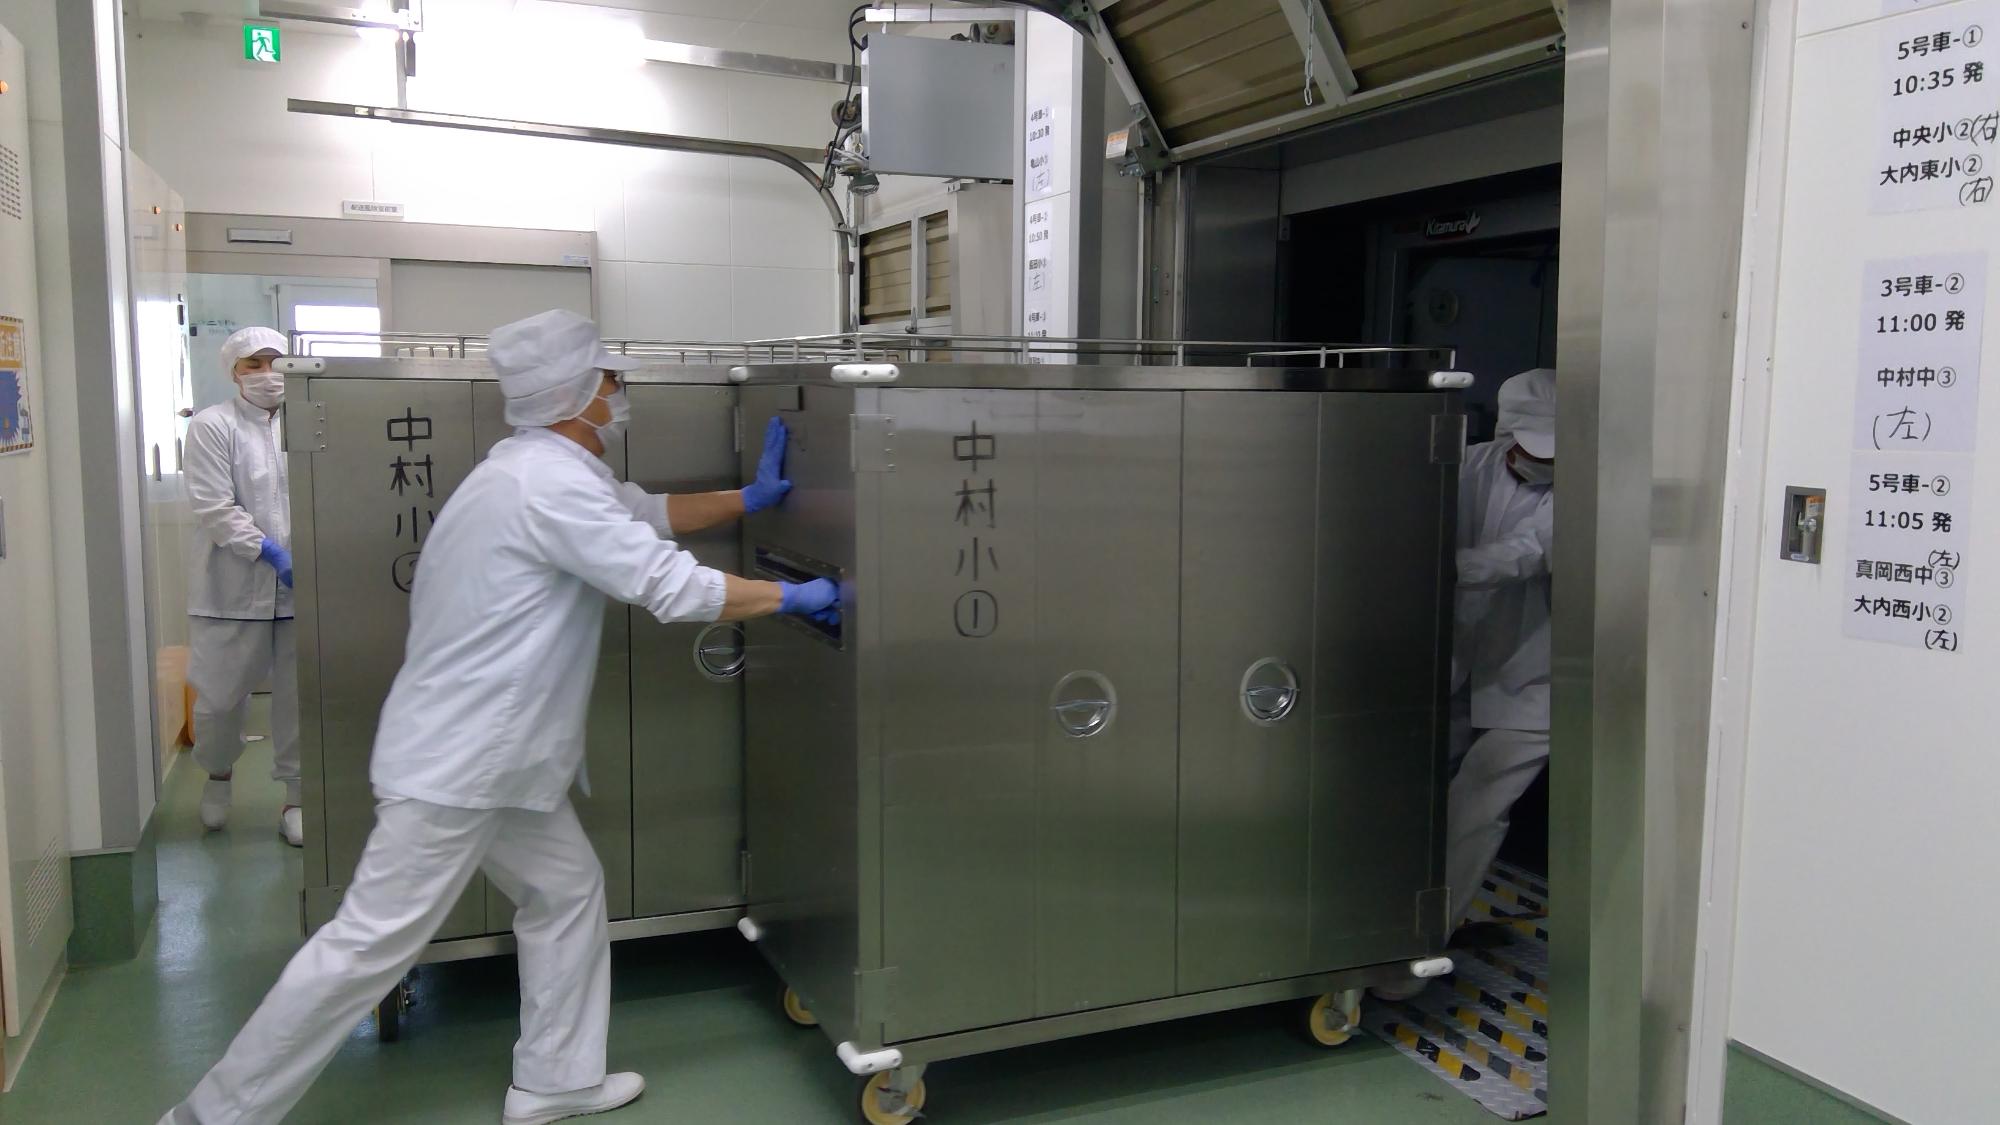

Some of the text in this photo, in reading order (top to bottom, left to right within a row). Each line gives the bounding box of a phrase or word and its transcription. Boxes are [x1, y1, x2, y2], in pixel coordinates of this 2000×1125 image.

[1898, 25, 1983, 60] 5号車-①
[1893, 61, 1984, 96] 10:35 発
[1880, 154, 1983, 186] 大内東小②
[1959, 176, 1993, 206] (右)
[1881, 273, 1964, 297] 3号車-②
[1877, 310, 1965, 333] 11:00 発
[1877, 366, 1956, 388] 中村中③
[1873, 406, 1931, 450] (左)
[1869, 474, 1950, 496] 5号車-②
[953, 420, 999, 638] 中村小①
[1865, 510, 1952, 533] 11:05 発
[1928, 549, 1960, 570] (左)
[1856, 560, 1954, 588] 真岡西中③
[1854, 595, 1952, 625] 大内西小②
[1925, 629, 1957, 651] (左)
